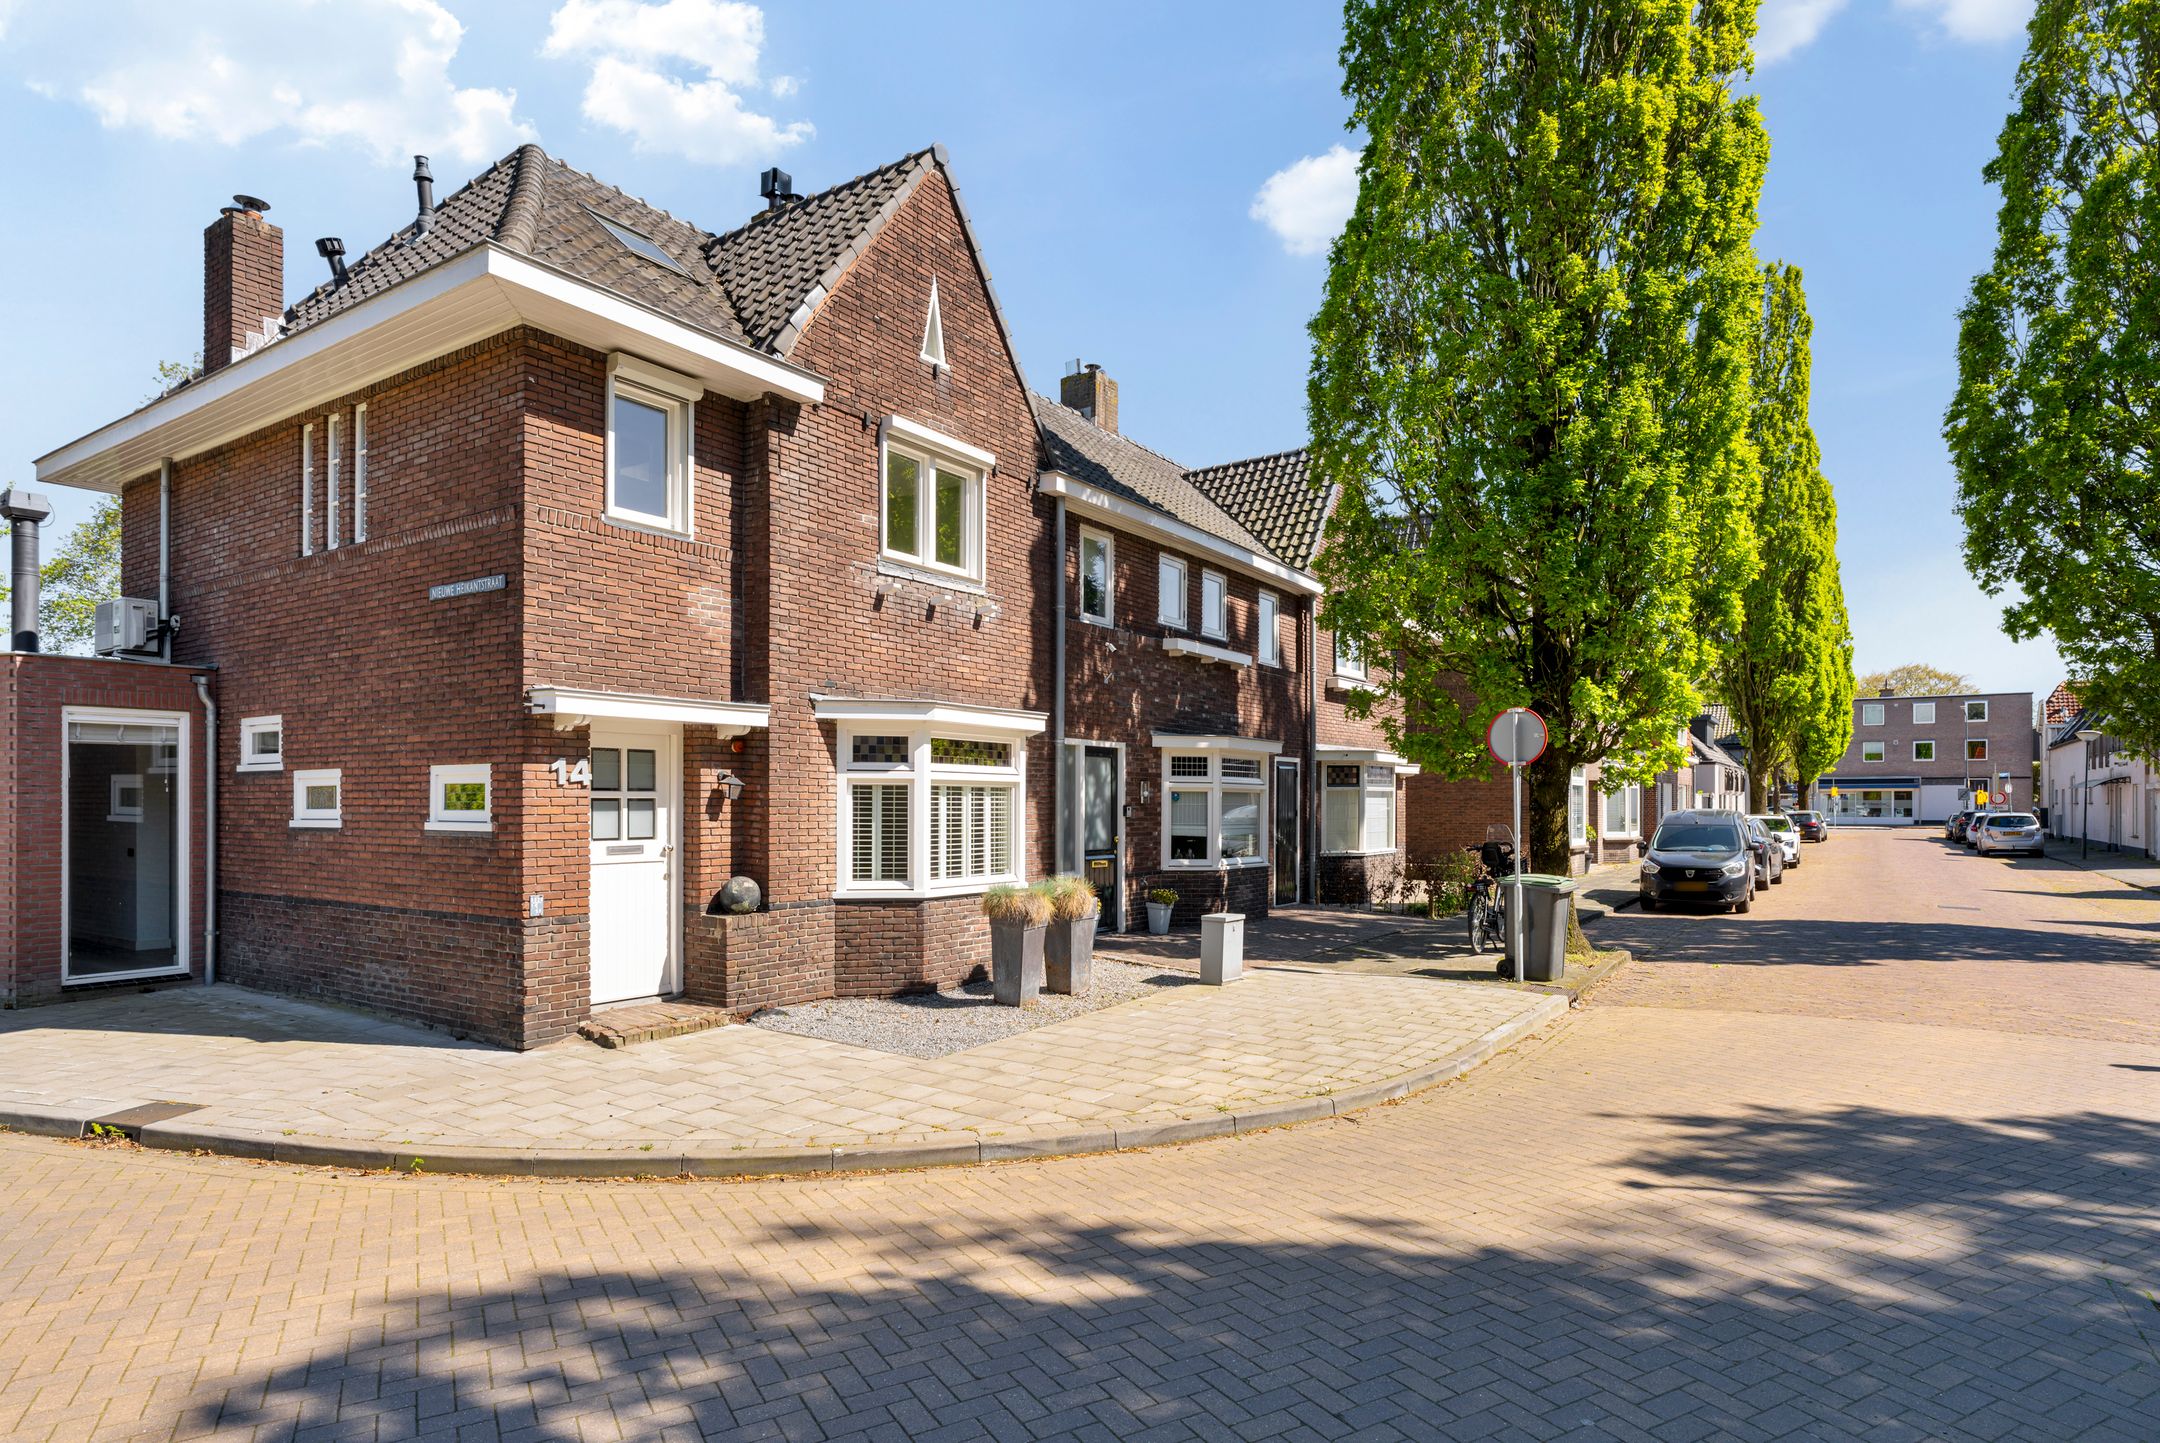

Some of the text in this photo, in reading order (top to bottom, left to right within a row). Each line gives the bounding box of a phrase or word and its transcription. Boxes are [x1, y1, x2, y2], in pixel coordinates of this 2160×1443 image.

[431, 576, 503, 598] NIEUWE HEIKANTSTRAAT
[550, 757, 593, 786] 14
